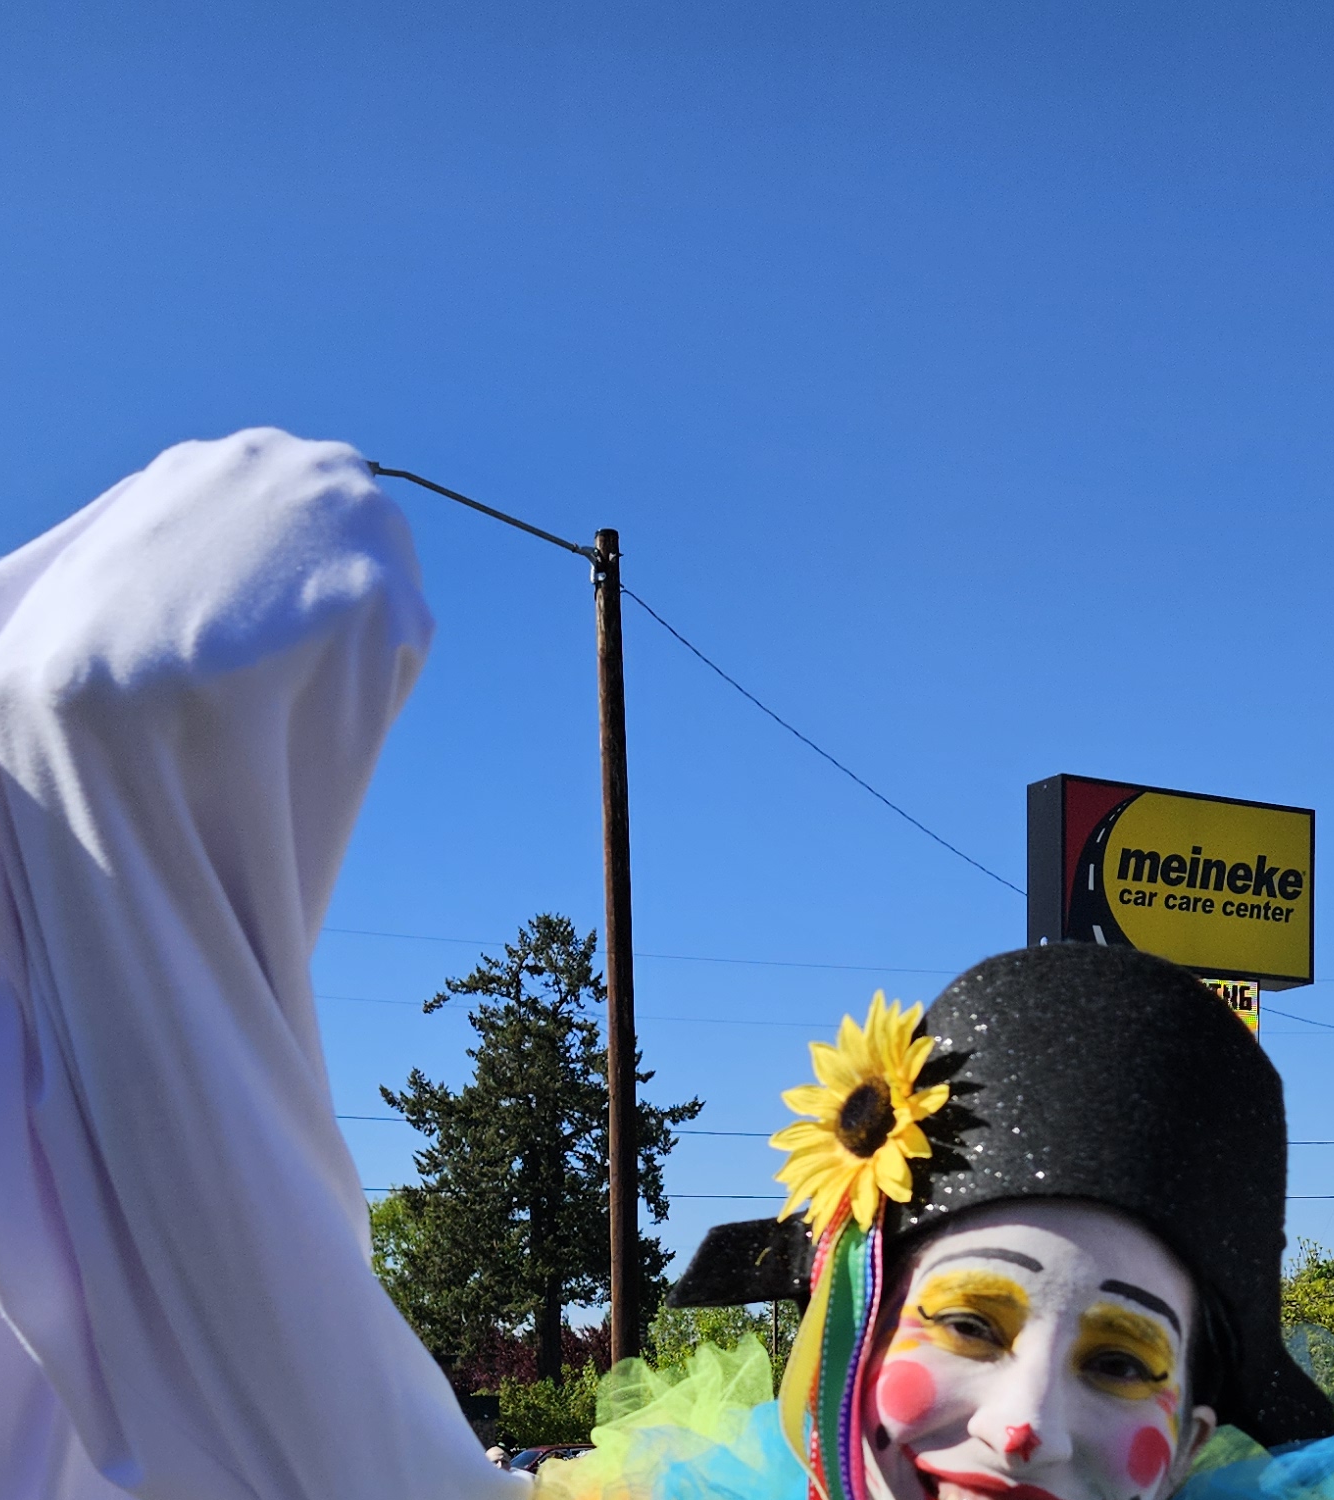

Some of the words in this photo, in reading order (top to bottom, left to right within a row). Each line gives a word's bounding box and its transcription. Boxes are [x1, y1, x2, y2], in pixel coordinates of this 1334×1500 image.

[1117, 845, 1303, 901] meineke
[1119, 888, 1158, 907] car
[1164, 893, 1215, 915] care
[1222, 900, 1294, 924] center
